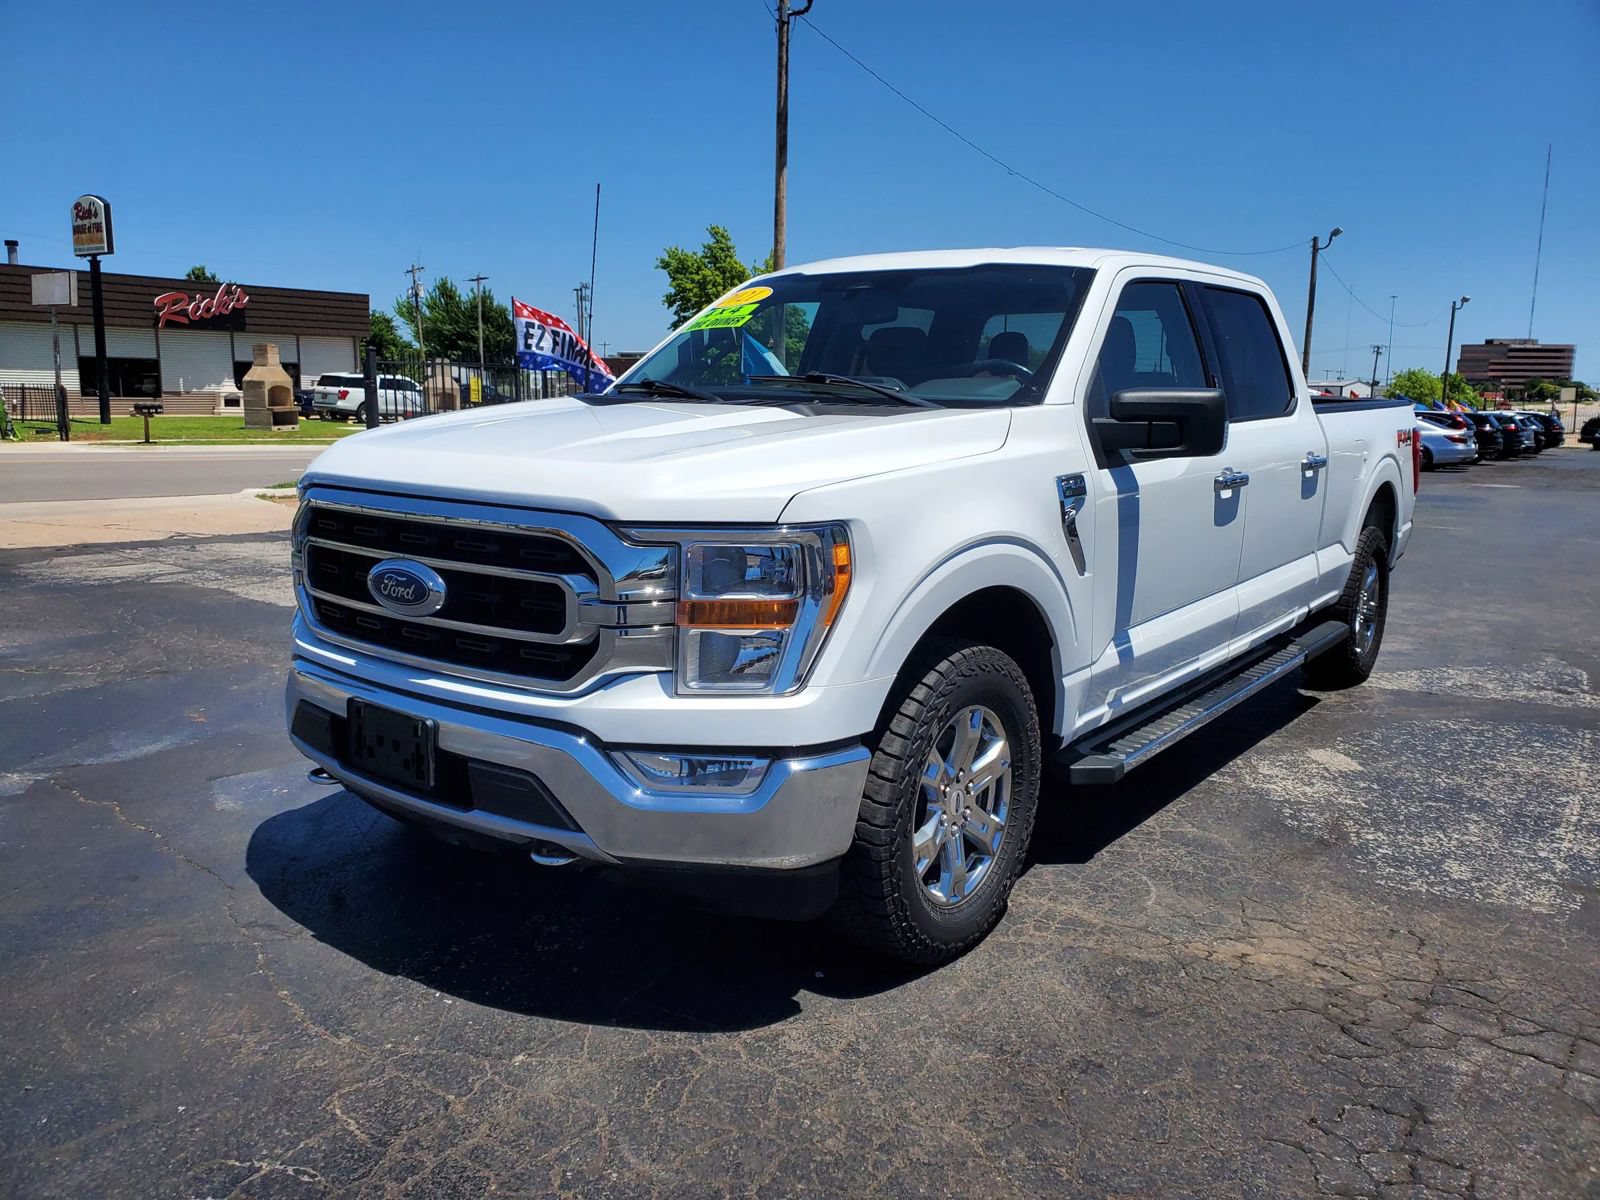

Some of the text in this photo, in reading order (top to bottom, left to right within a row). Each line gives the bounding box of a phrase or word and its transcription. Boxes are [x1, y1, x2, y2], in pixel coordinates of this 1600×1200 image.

[74, 201, 99, 222] Rick's
[154, 283, 250, 328] Rick's
[524, 321, 546, 351] EZ
[381, 573, 416, 600] Ford
